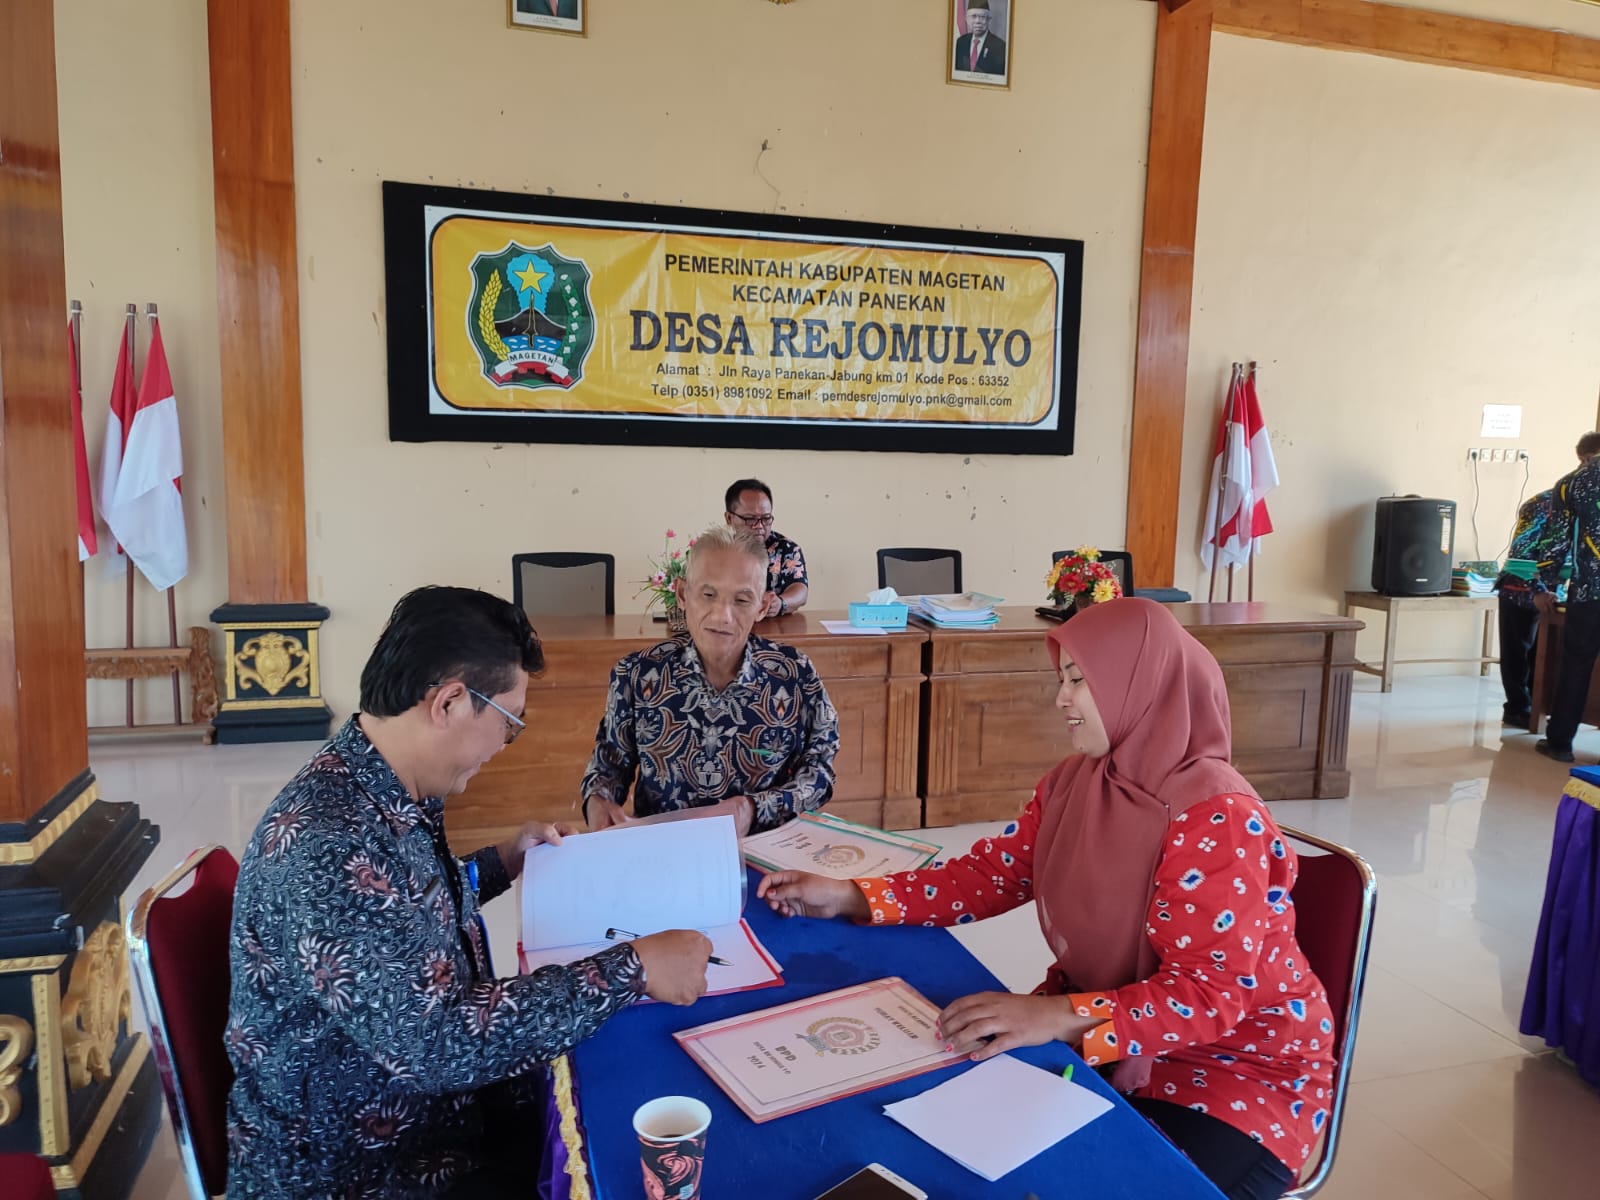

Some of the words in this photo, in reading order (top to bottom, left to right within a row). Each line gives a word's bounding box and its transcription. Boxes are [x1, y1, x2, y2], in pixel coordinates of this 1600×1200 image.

[665, 254, 793, 278] PEMERINTAH
[799, 262, 913, 286] KABUPATEN
[918, 270, 1005, 292] MAGETAN
[732, 284, 853, 308] KECAMATAN
[858, 292, 946, 312] PANEKAN
[629, 309, 755, 357] DESA
[769, 317, 1032, 368] REJOMULYO
[509, 351, 555, 364] MAGETAN
[656, 362, 700, 376] Alamat
[718, 365, 737, 377] Jln
[741, 365, 771, 381] Raya
[775, 367, 873, 384] Panekan-Jabung
[875, 370, 893, 383] km
[895, 372, 909, 384] 01
[915, 373, 945, 385] Kode
[947, 374, 969, 386] Pos
[978, 375, 1010, 387] 63352
[651, 383, 679, 399] Telp
[682, 384, 720, 400] (0351)
[723, 386, 773, 400] 8981092
[777, 388, 811, 401] Email
[821, 390, 1013, 408] pemdesrejomulyo.pnk@gmail.com
